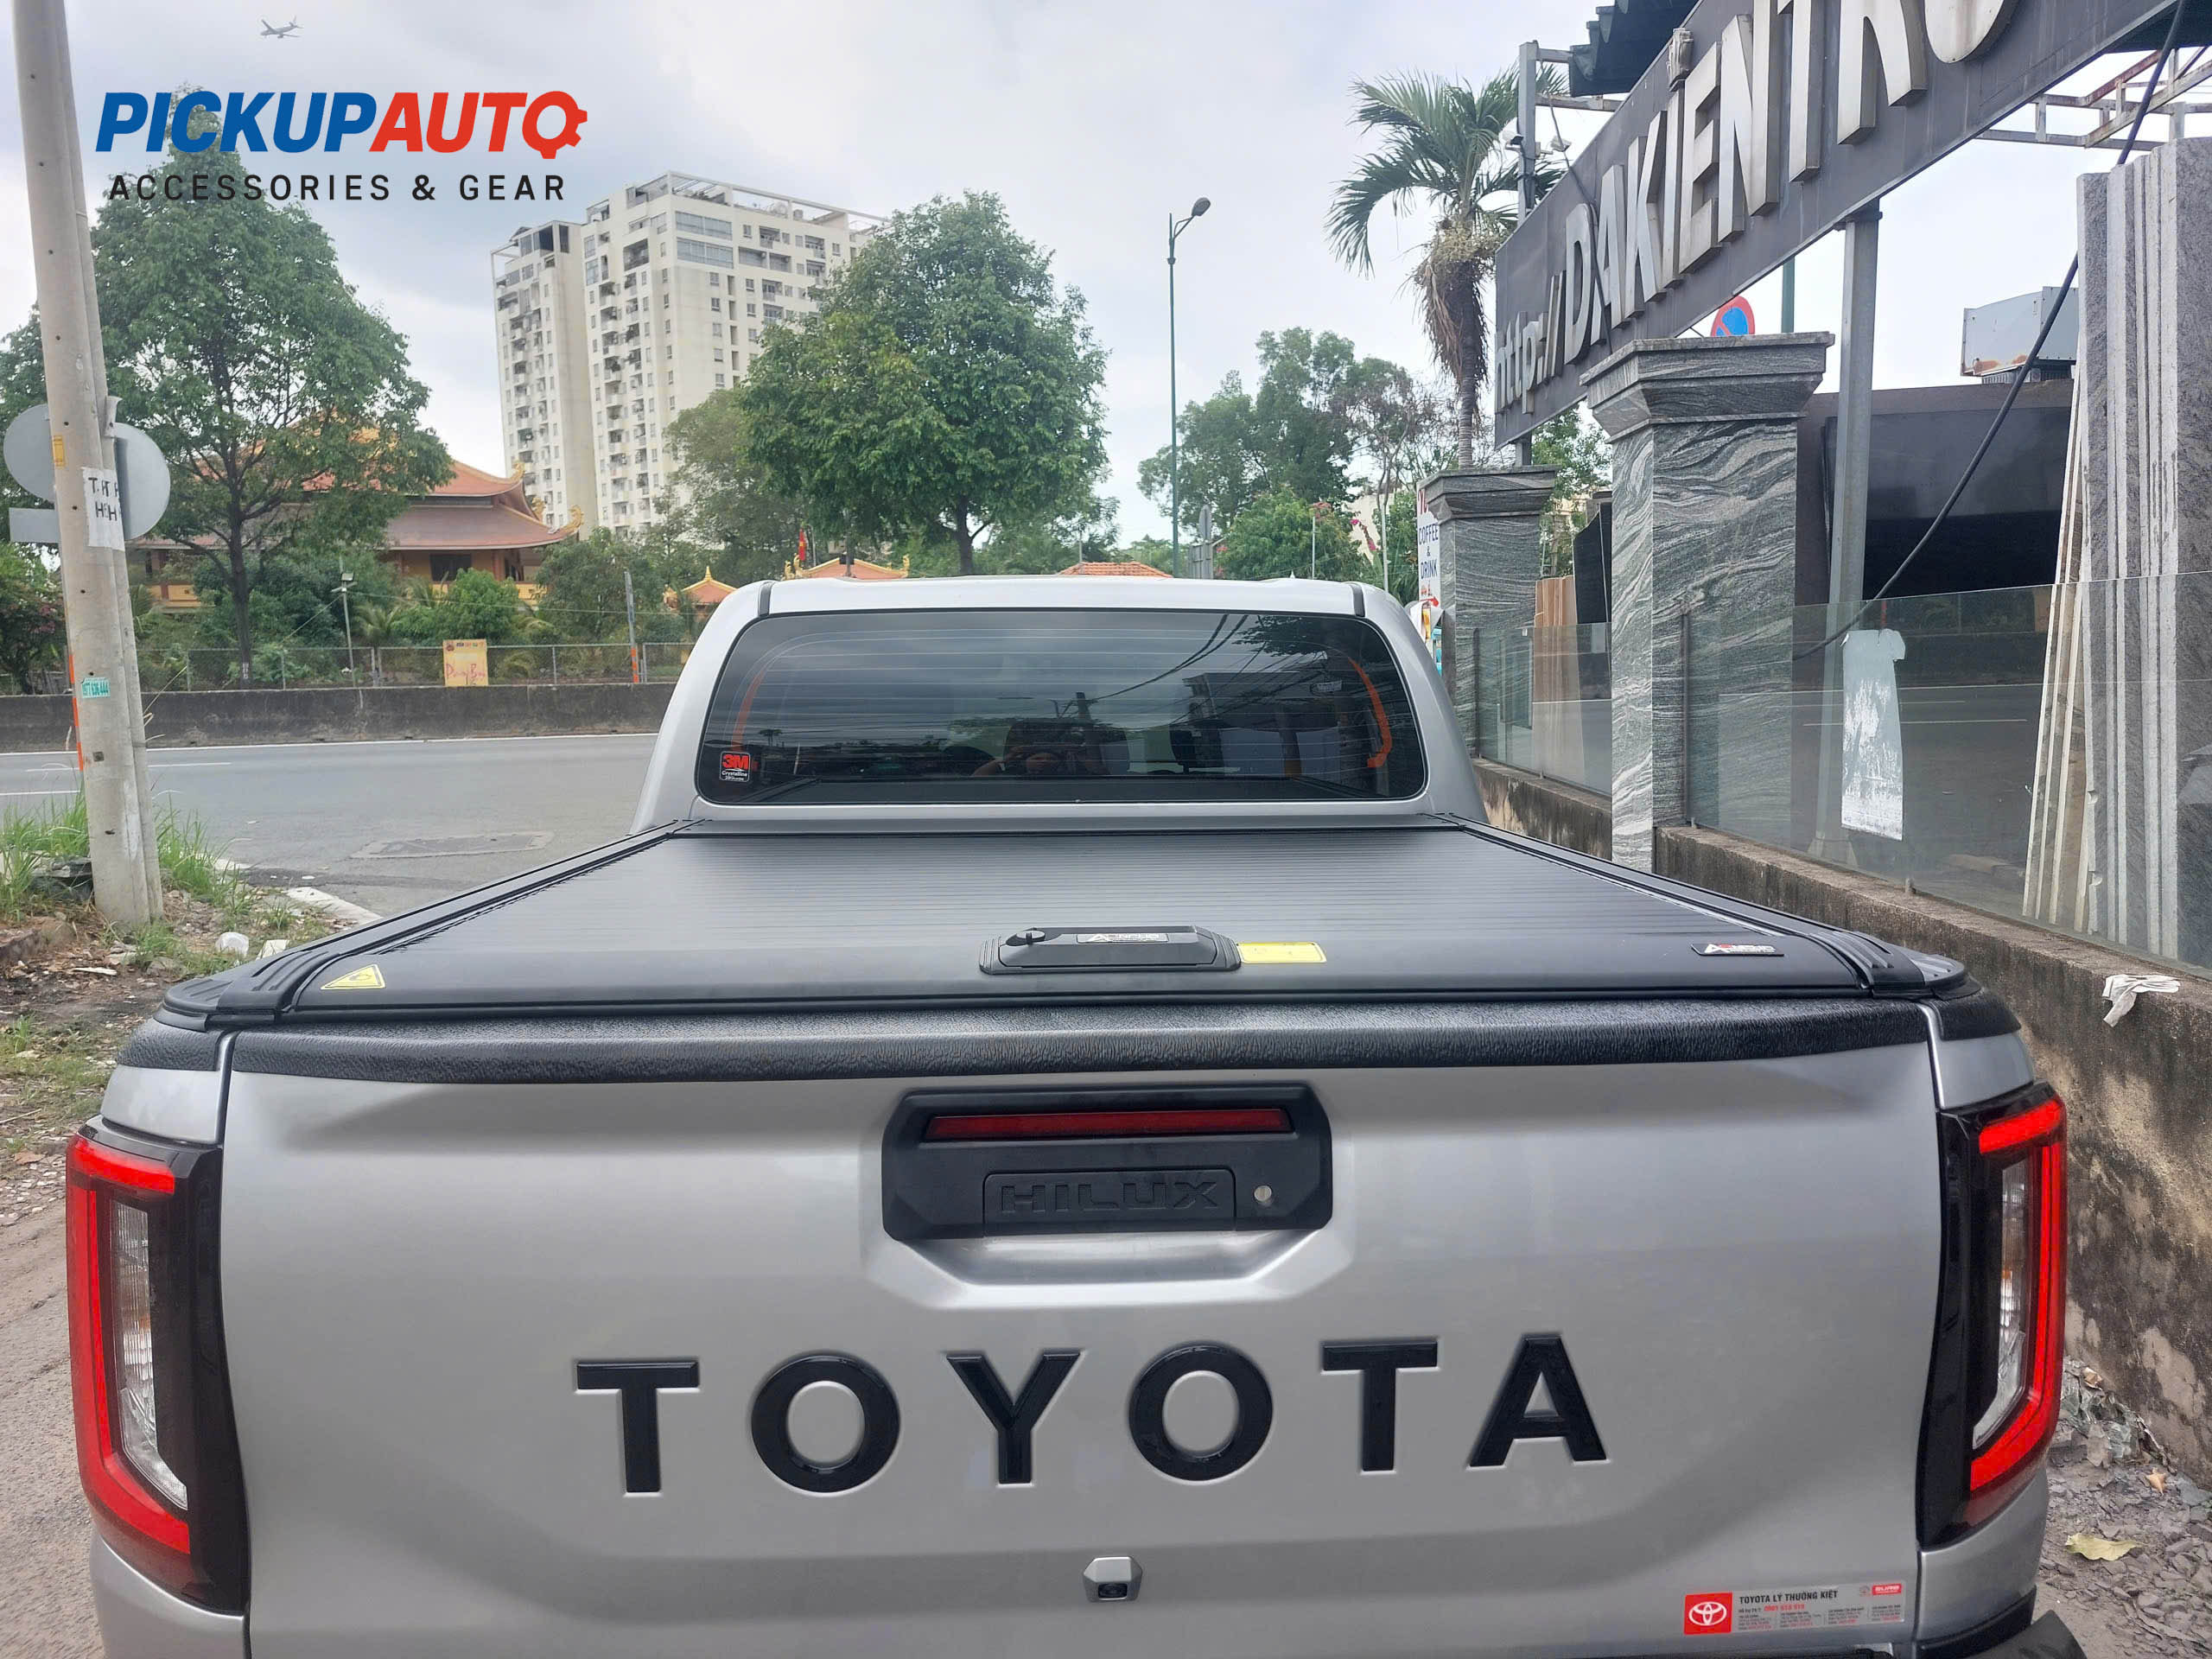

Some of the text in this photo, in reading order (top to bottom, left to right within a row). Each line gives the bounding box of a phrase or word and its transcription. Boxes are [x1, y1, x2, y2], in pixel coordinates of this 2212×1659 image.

[1418, 523, 1439, 545] COFFEE
[1420, 558, 1438, 580] DRINK
[721, 753, 749, 770] 3M
[1000, 1180, 1219, 1214] HILUX
[573, 1333, 1609, 1495] TOYOTA
[1738, 1595, 1771, 1605] TOYOTA
